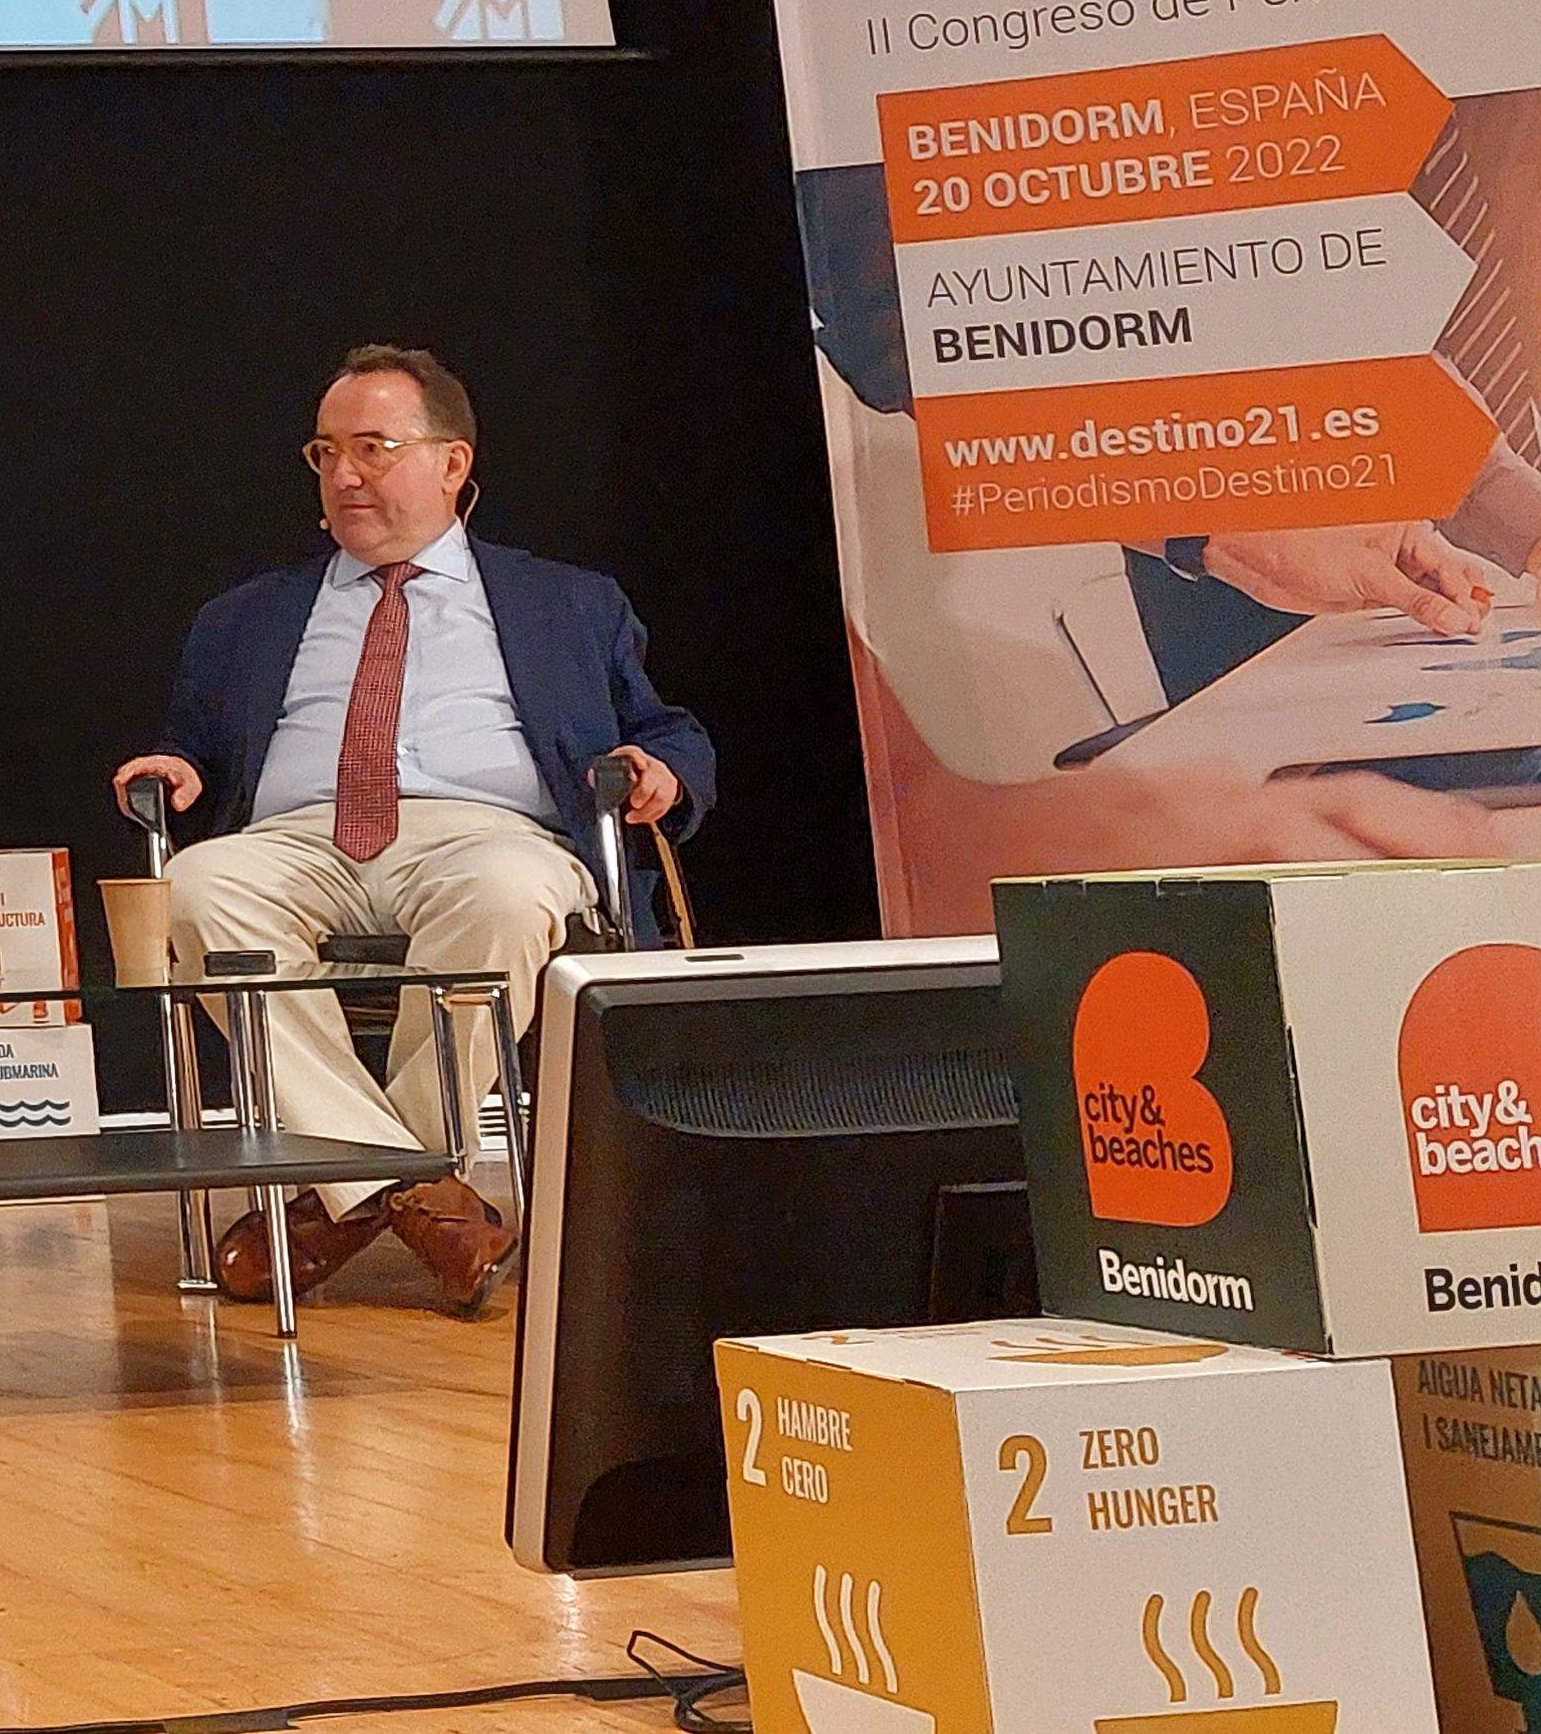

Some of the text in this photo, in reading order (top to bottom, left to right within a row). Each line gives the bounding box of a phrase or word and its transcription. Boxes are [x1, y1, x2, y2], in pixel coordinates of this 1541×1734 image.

[866, 17, 894, 55] II
[907, 67, 1386, 161] BENIDORM, ESPAÑA
[913, 133, 1348, 217] 20 OCTUBRE 2022
[926, 227, 1387, 309] AYUNTAMIENTO DE
[932, 306, 1194, 365] BENIDORM
[944, 406, 1380, 469] www.destino21.es
[951, 453, 1398, 517] #PeriodismoDestino21
[0, 895, 6, 907] I
[1083, 1083, 1166, 1136] city&
[1411, 1079, 1533, 1139] city&
[1088, 1130, 1215, 1175] beaches
[1098, 1248, 1255, 1312] Benidorm
[1417, 1359, 1485, 1403] AIGUA
[736, 1388, 768, 1486] 2
[777, 1395, 853, 1453] HAMBRE
[1079, 1426, 1160, 1471] ZERO
[1423, 1413, 1431, 1449] I
[781, 1455, 830, 1505] CERO
[999, 1434, 1053, 1535] 2
[1086, 1483, 1219, 1532] HUNGER
